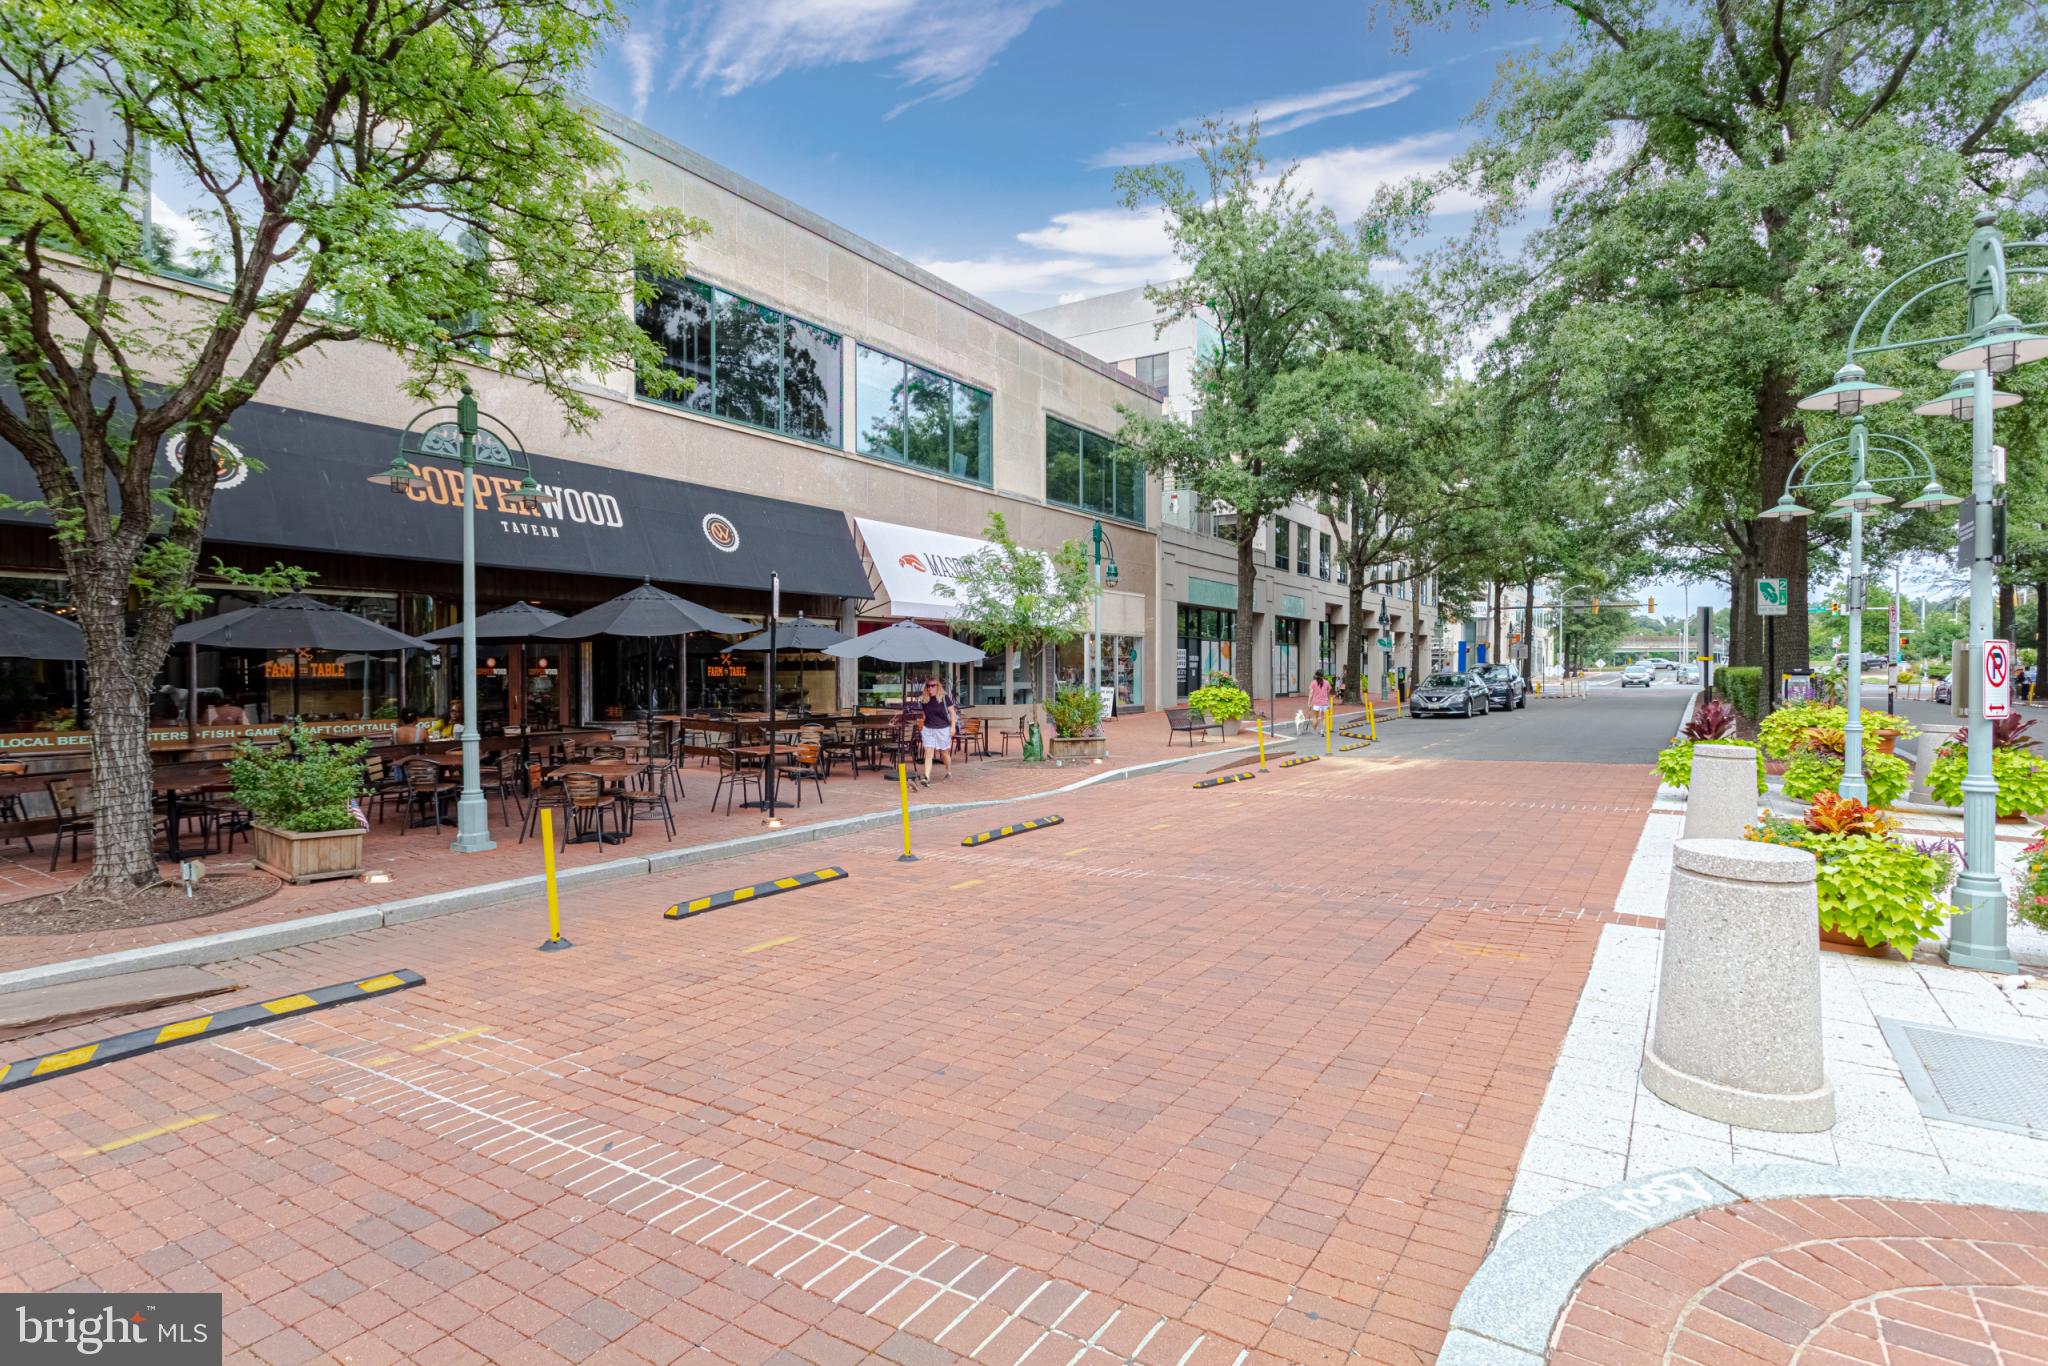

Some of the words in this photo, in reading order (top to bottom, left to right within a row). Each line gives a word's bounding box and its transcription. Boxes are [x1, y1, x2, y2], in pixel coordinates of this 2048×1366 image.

[500, 521, 560, 538] TAVERN
[311, 663, 345, 677] TABLE
[707, 666, 724, 677] FARM
[729, 666, 747, 677] TABLE
[0, 737, 54, 748] LOCAL
[57, 735, 92, 746] BEE
[201, 729, 235, 739] FISH
[333, 722, 398, 734] COCKTAILS
